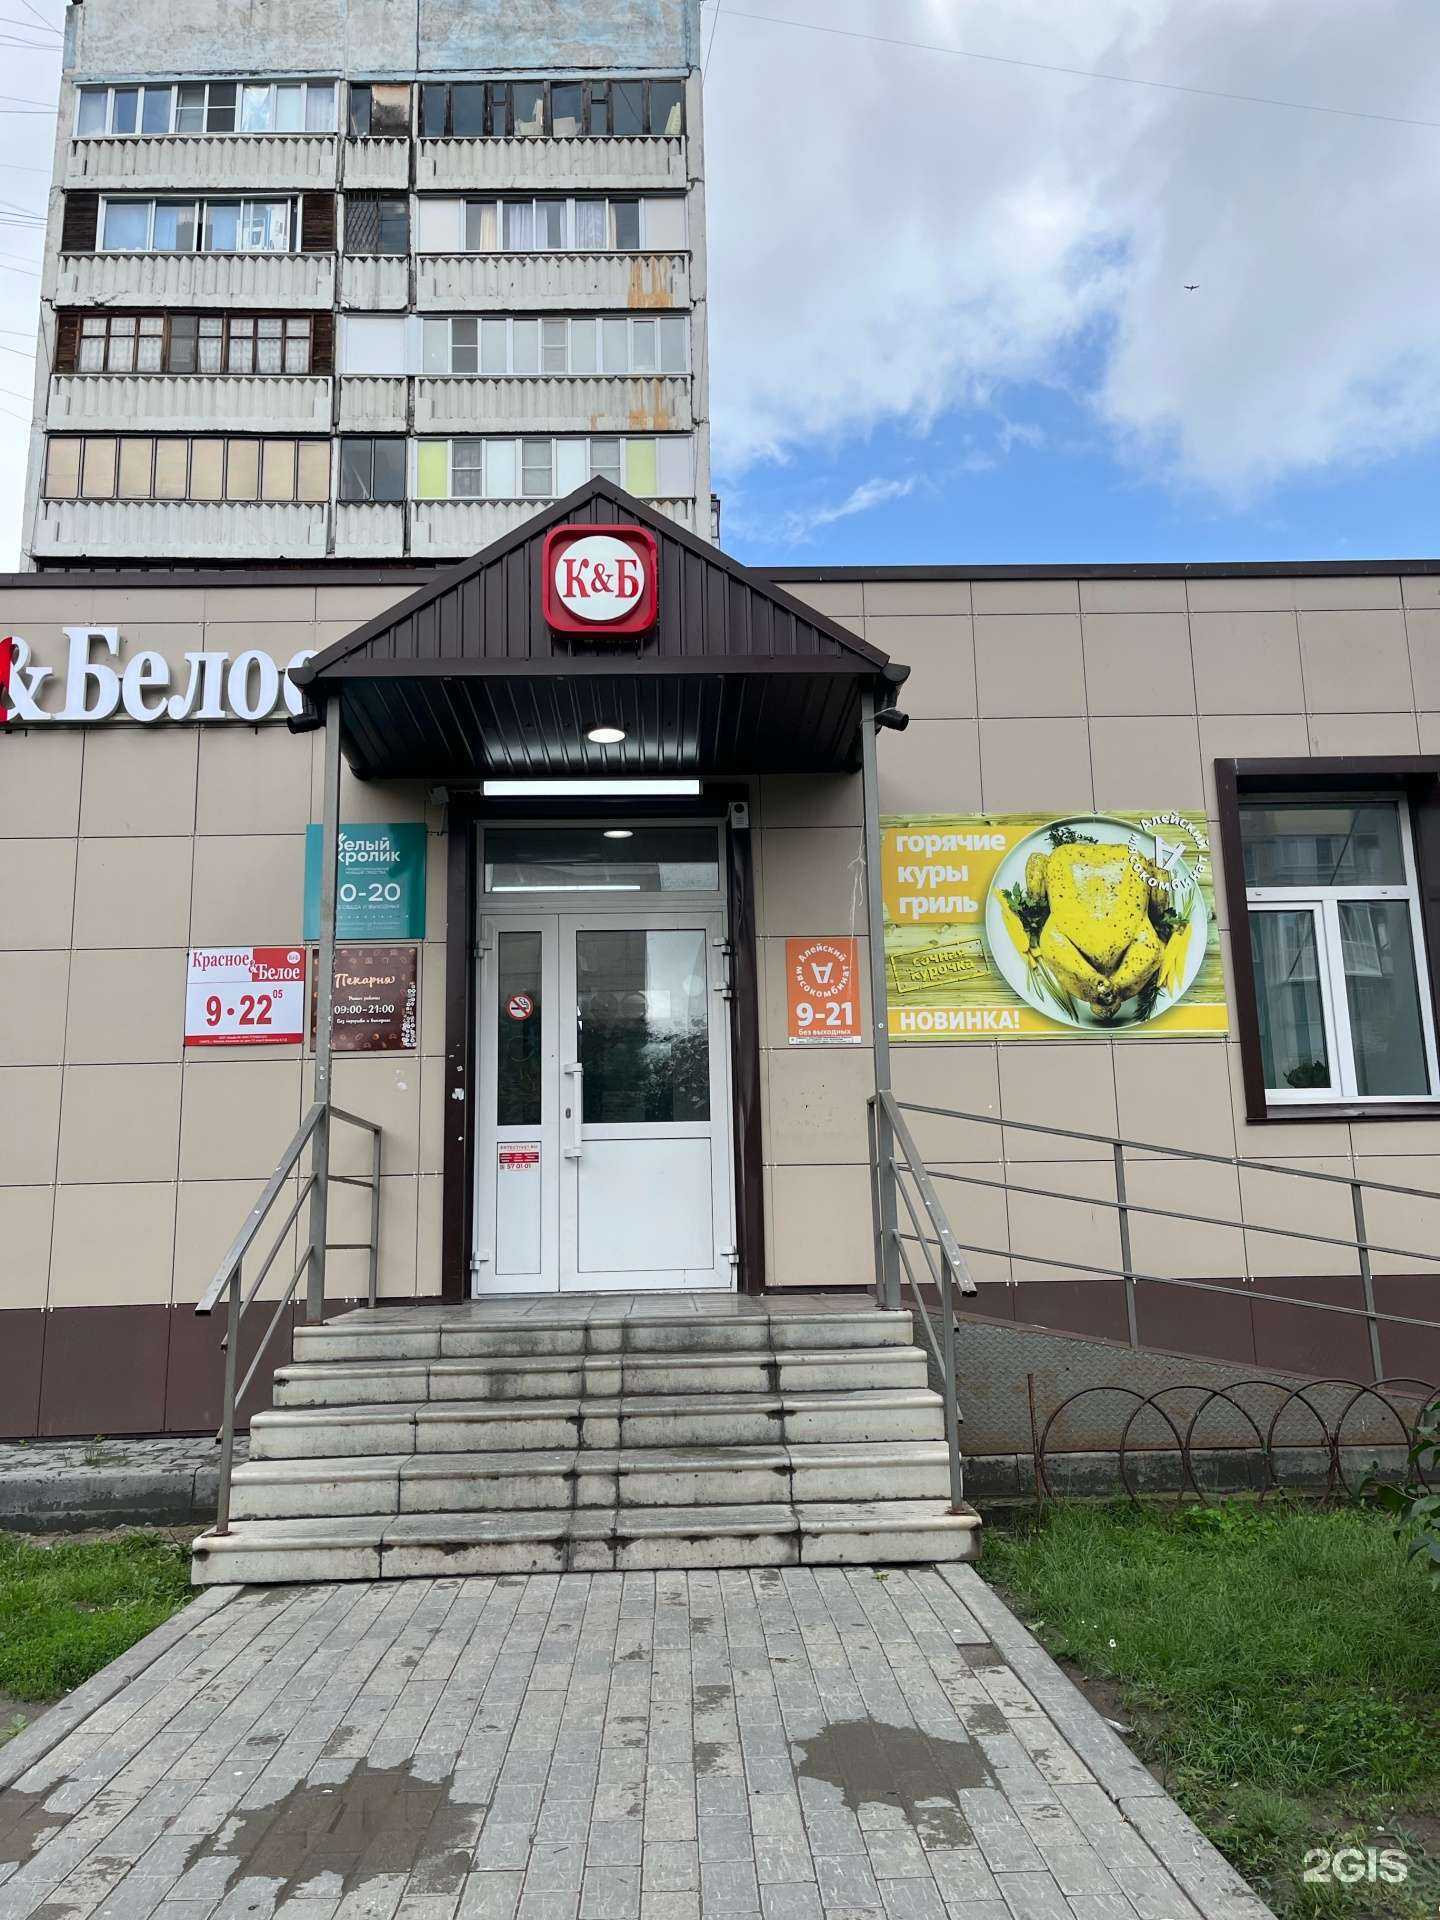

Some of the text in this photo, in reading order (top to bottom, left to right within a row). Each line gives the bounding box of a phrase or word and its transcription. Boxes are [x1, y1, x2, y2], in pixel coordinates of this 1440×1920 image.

[562, 558, 640, 598] К&Б
[896, 832, 1006, 858] горячие
[897, 864, 969, 888] куры
[898, 895, 979, 919] гриль
[798, 943, 848, 963] Алейский
[912, 949, 968, 967] сочная
[192, 951, 250, 972] Красное
[255, 963, 301, 980] Белое
[334, 973, 396, 989] Пекарня
[795, 965, 850, 998] мясокомбинат
[796, 1001, 853, 1027] 9-21
[900, 1009, 1021, 1031] НОВИНКА!
[798, 1028, 851, 1037] без выходных
